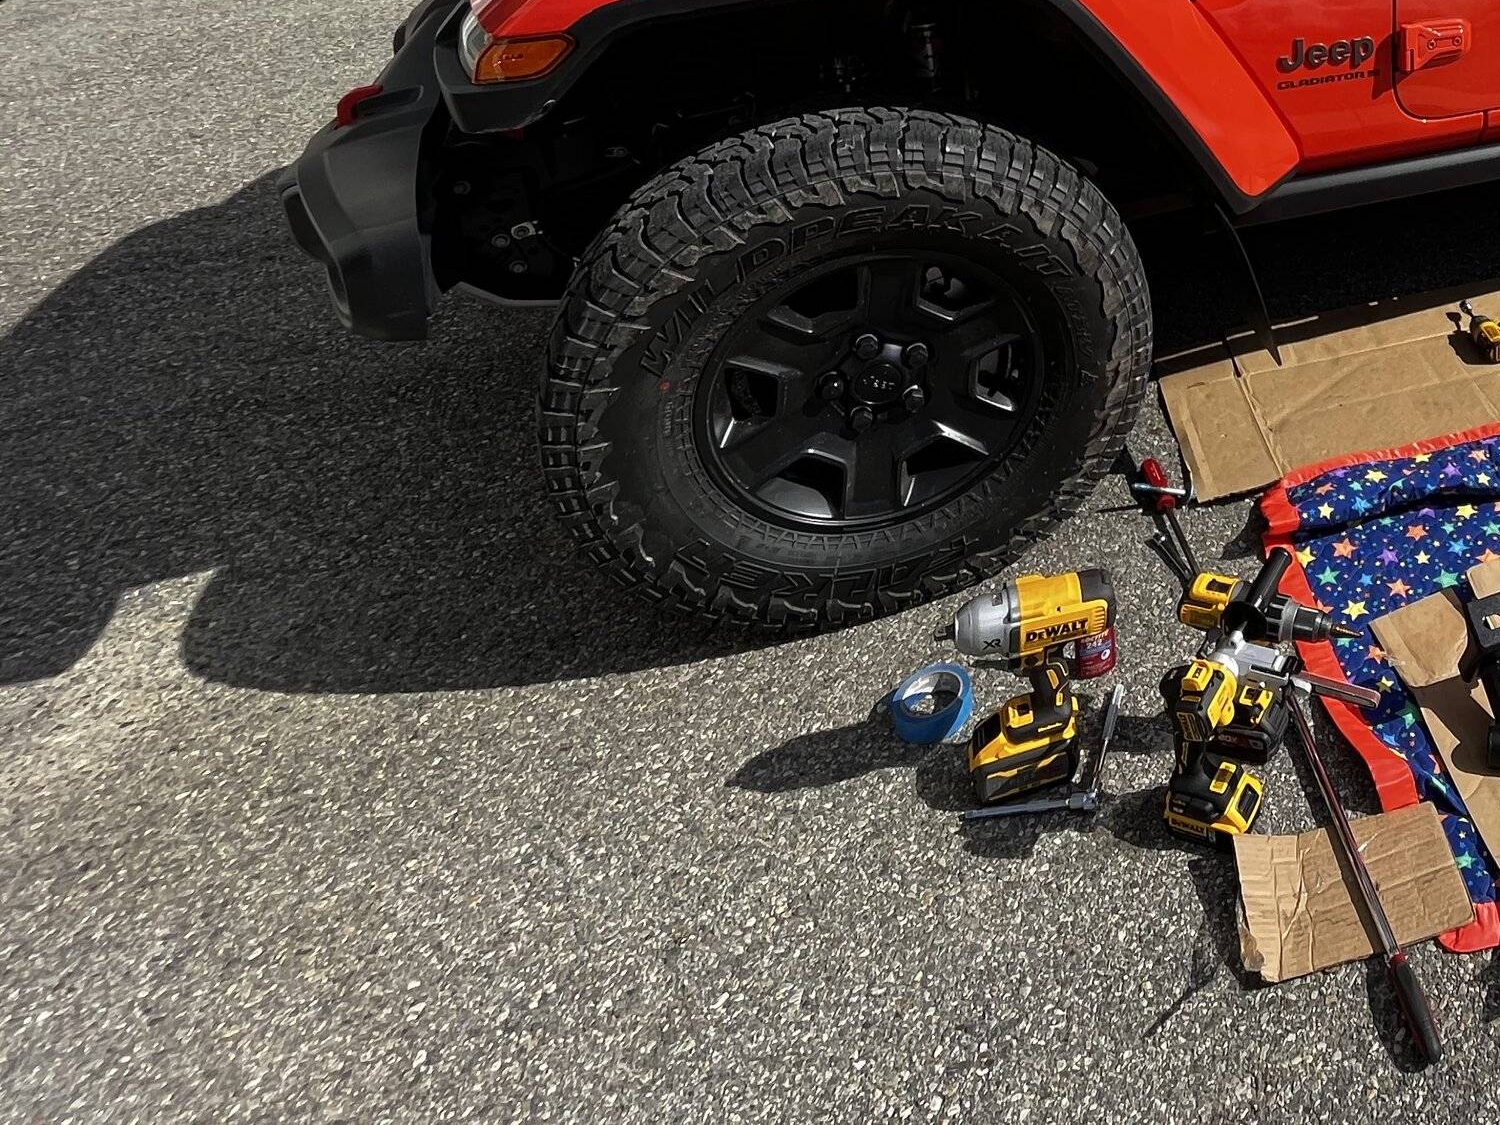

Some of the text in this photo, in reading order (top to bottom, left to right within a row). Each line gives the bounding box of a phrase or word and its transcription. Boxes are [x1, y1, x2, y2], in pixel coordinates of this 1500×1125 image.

[1276, 36, 1375, 73] Jeep
[1277, 71, 1365, 91] GLADIATOR
[982, 638, 1003, 650] XR
